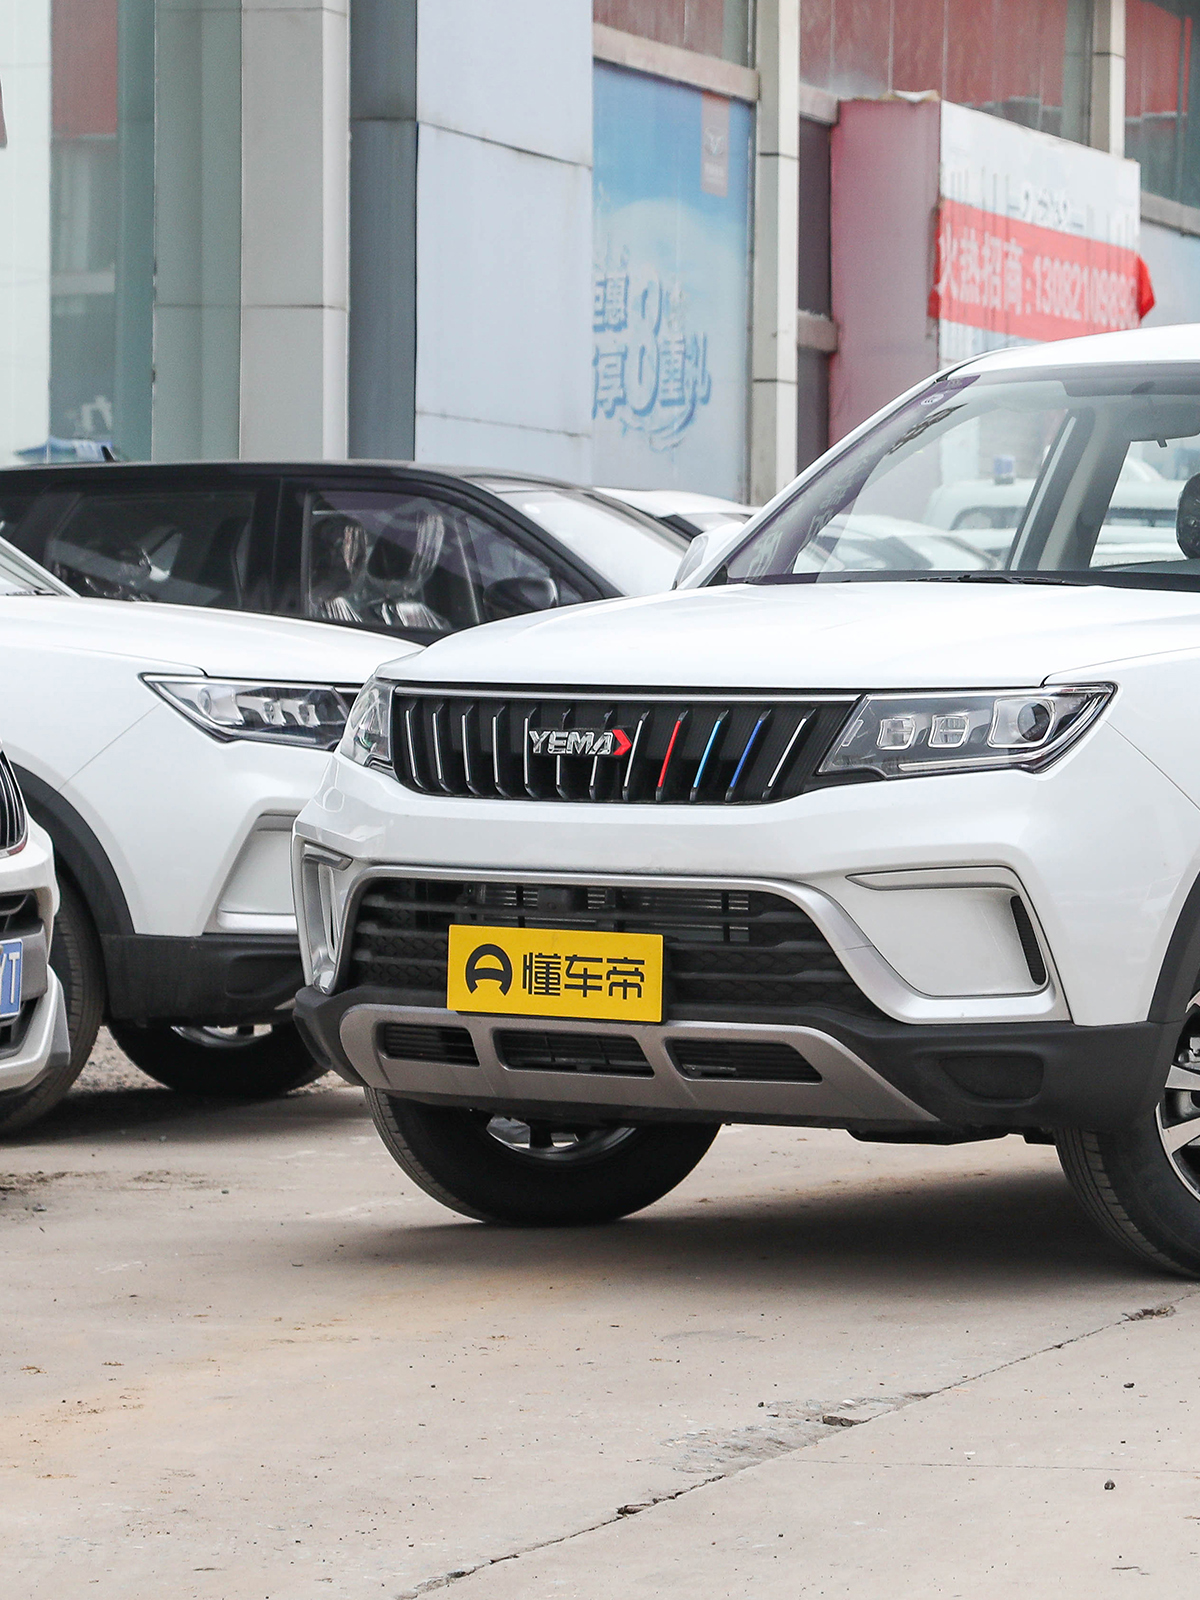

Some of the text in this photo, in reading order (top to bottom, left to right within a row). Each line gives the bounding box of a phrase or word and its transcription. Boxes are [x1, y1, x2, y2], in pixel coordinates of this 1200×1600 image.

[528, 730, 614, 756] YEMA
[522, 952, 645, 1000] 懂车帝
